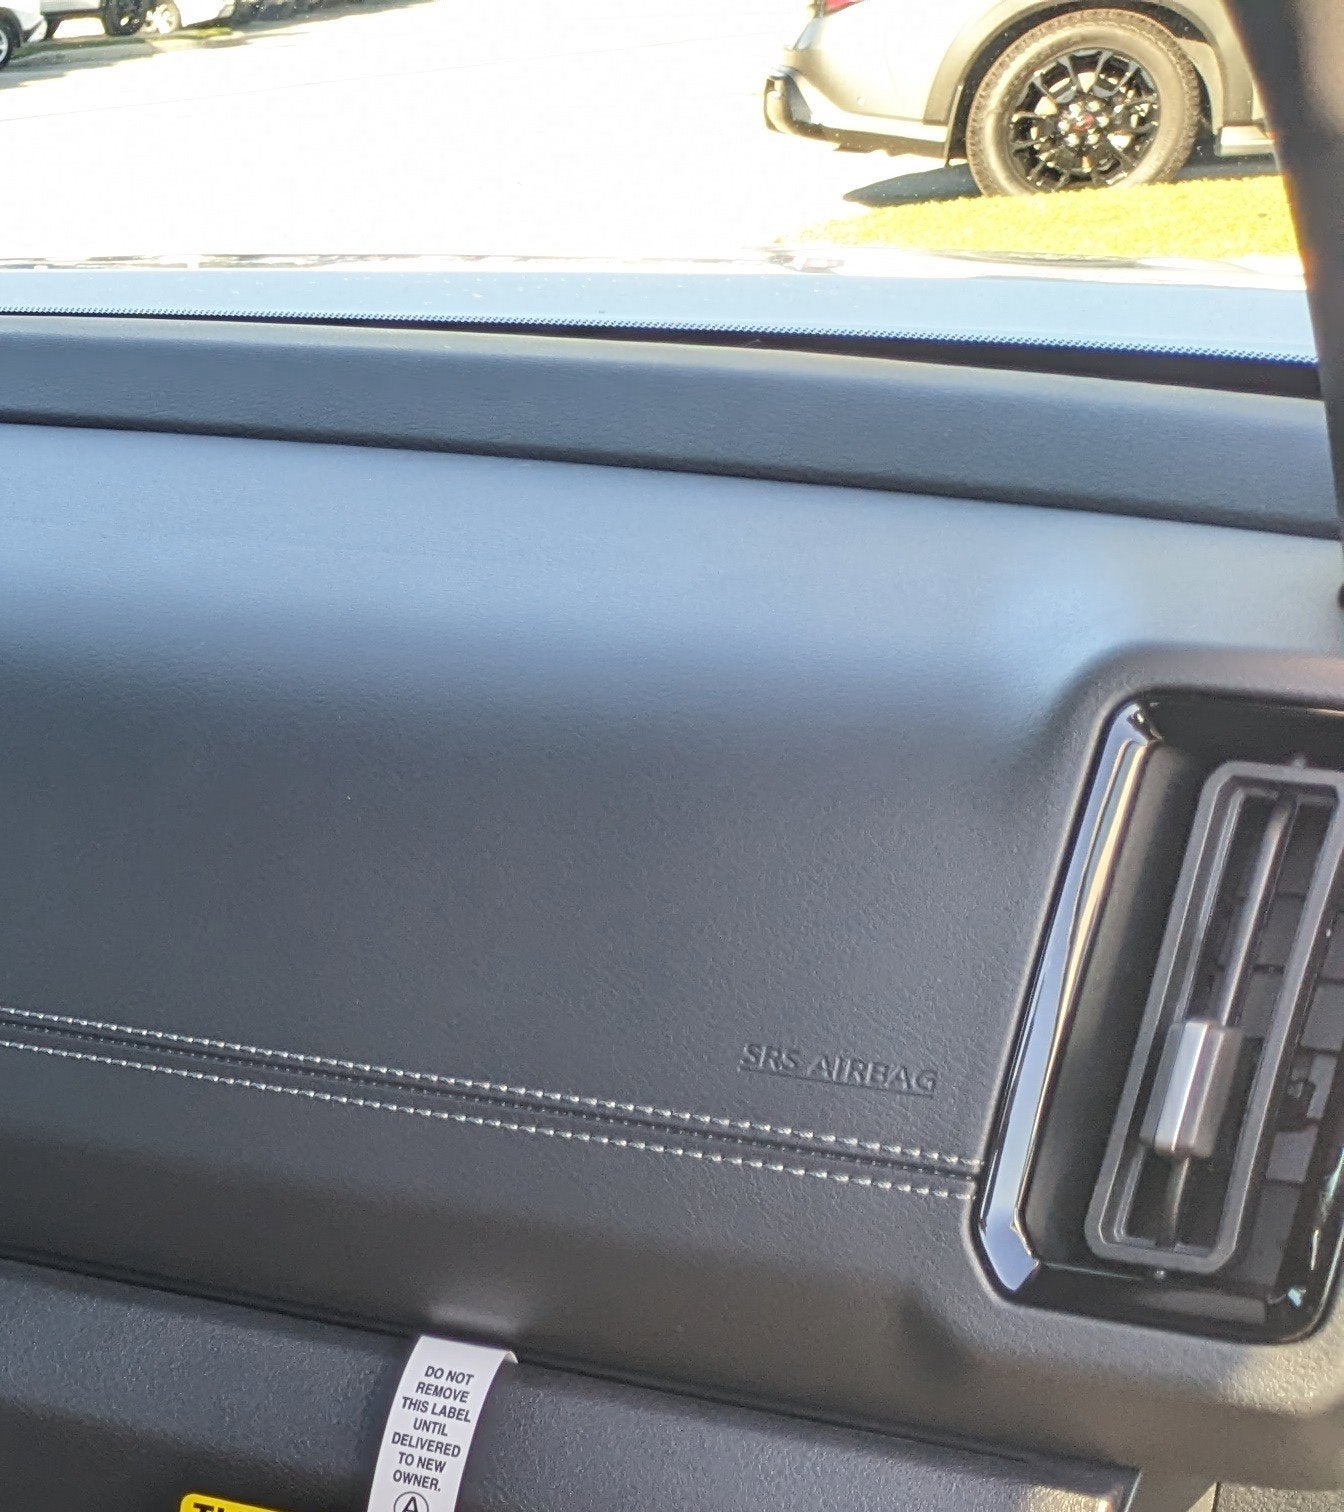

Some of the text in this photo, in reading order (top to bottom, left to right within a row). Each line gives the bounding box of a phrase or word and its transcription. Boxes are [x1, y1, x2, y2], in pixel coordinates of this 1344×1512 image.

[739, 1043, 940, 1094] SRS AIRBAG
[424, 1365, 475, 1386] DO NOT
[415, 1381, 470, 1404] REMOVE
[402, 1396, 471, 1423] THIS LABEL
[413, 1417, 448, 1437] UNTIL
[391, 1431, 462, 1458] DELIVERED
[398, 1451, 447, 1474] TO NEW
[392, 1469, 442, 1492] OWNER.
